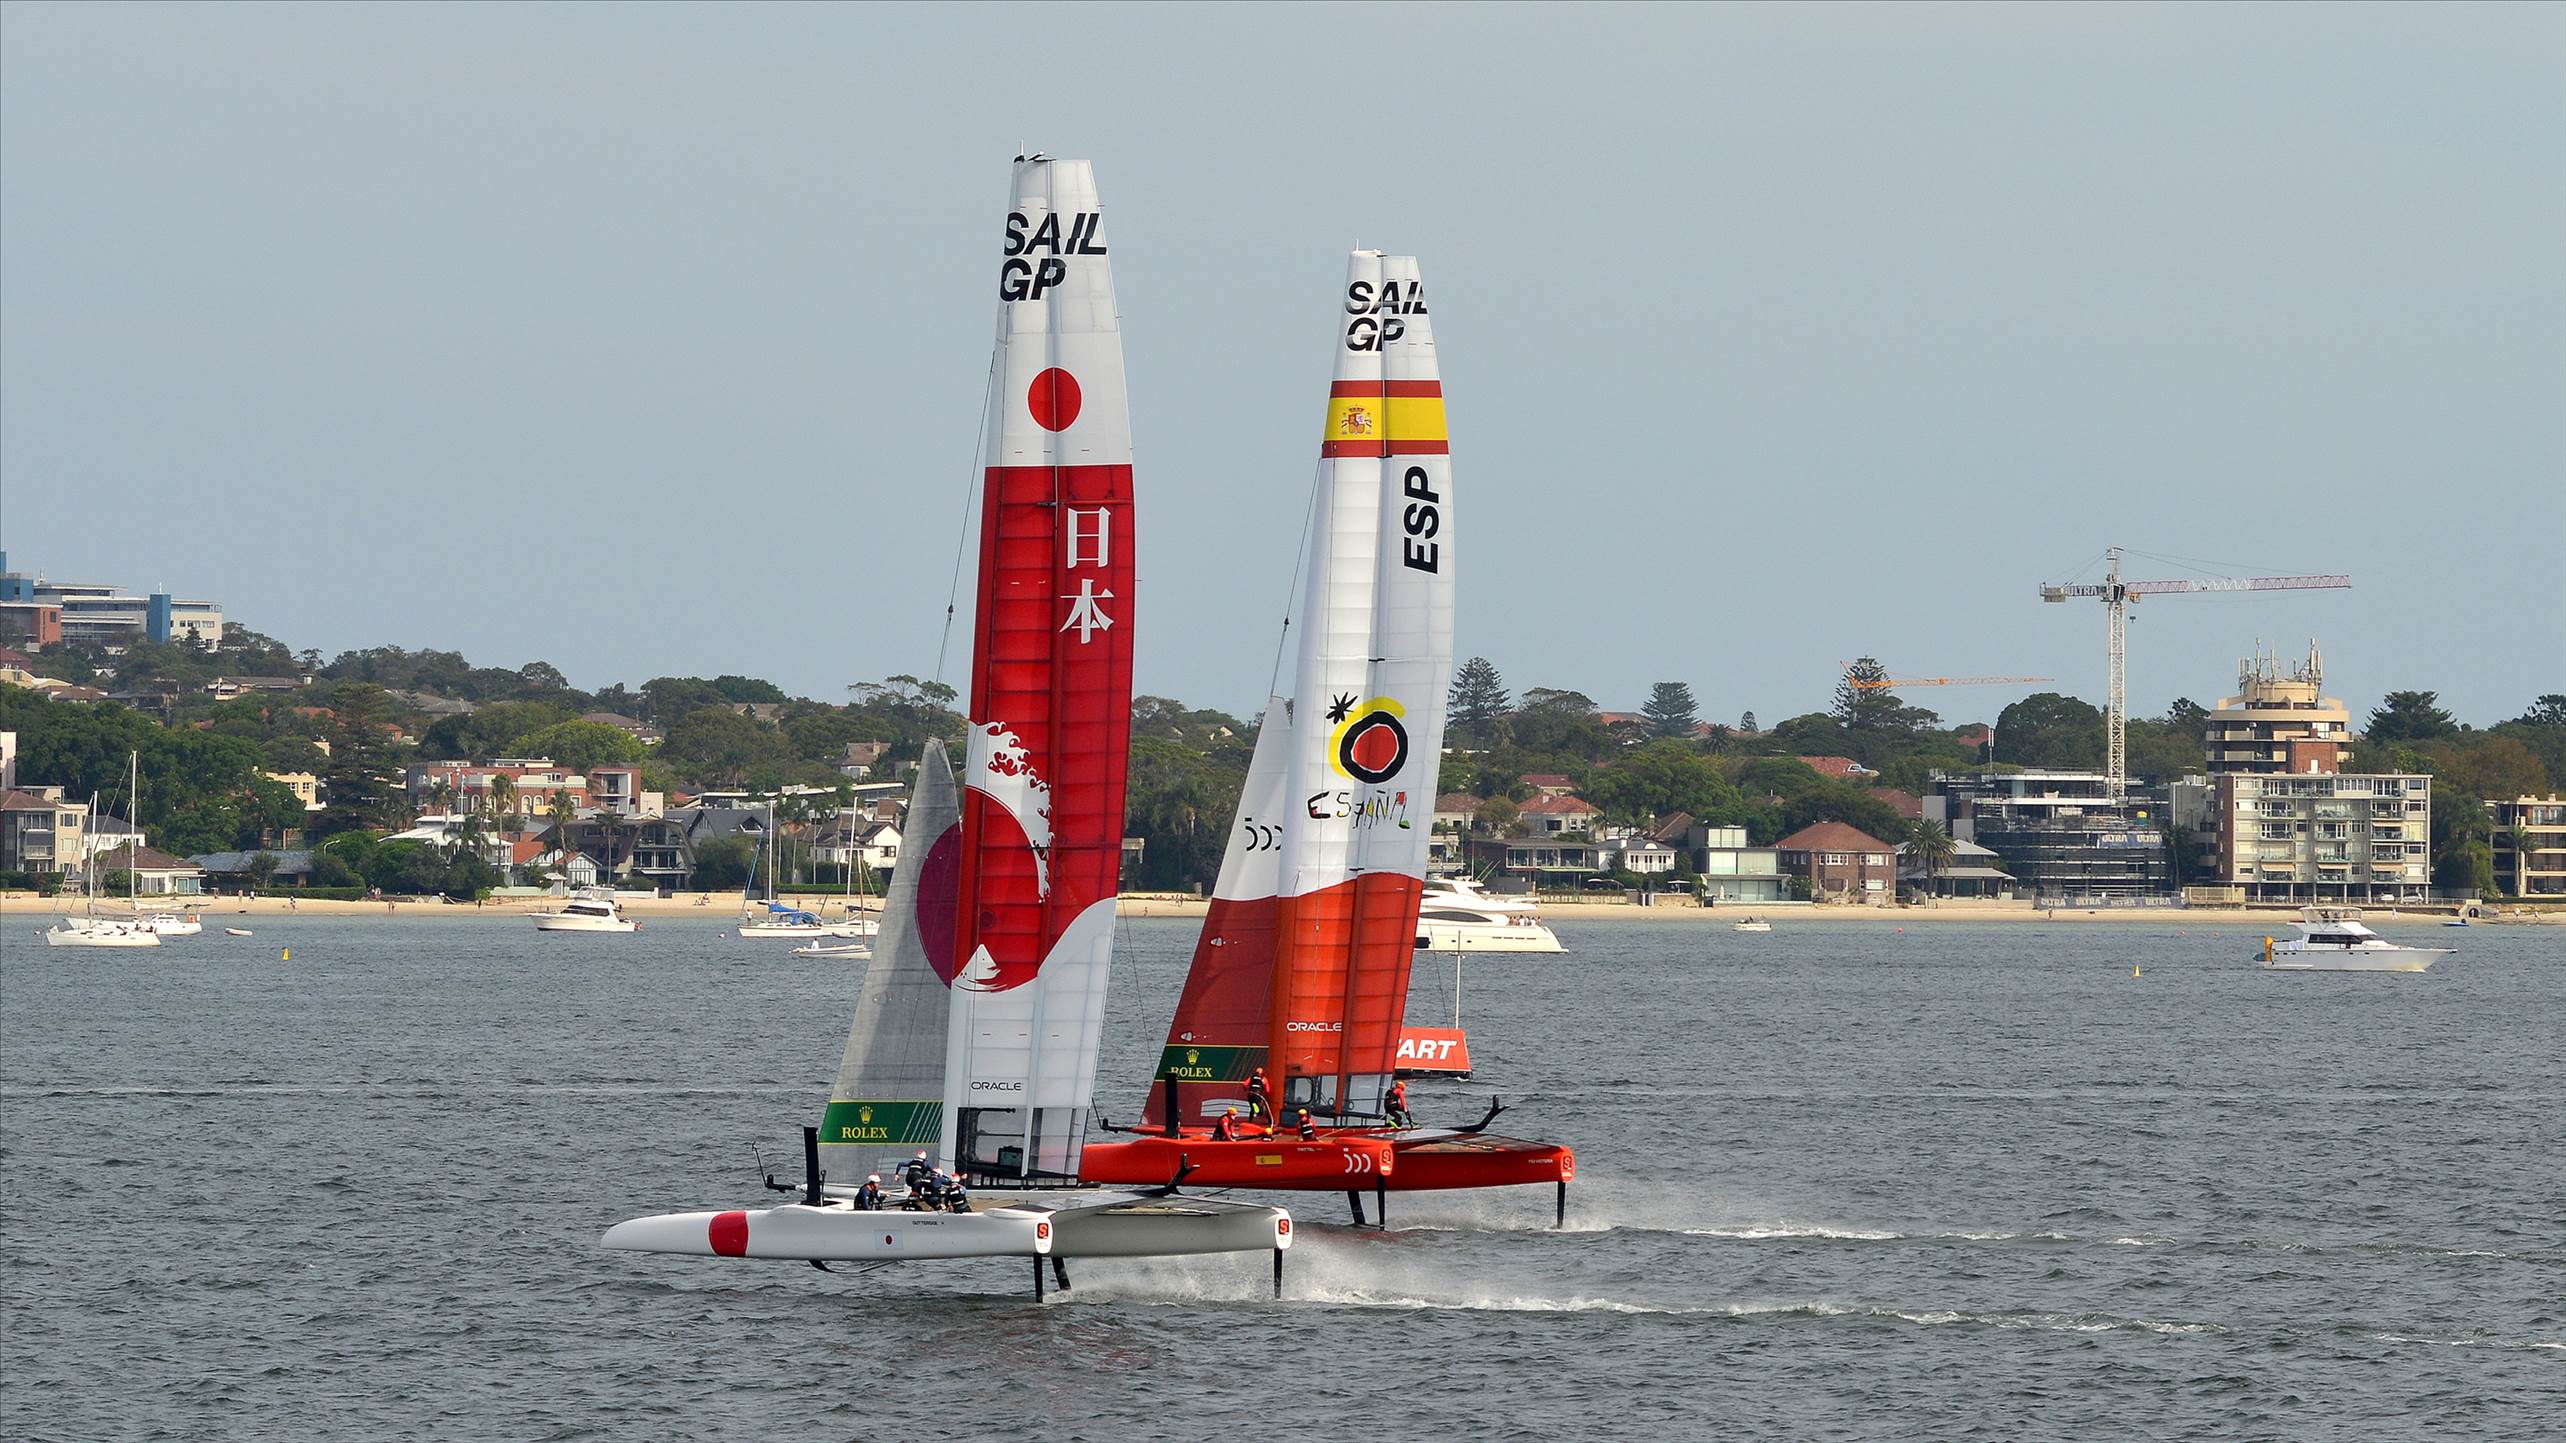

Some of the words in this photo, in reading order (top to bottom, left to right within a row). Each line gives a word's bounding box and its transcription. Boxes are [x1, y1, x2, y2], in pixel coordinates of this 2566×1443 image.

[1004, 212, 1106, 255] SAIL
[1000, 258, 1066, 301] GP
[1345, 281, 1428, 315] SAIL
[1345, 317, 1405, 351] GP
[1404, 466, 1439, 574] ESP
[1059, 506, 1114, 644] 日本
[1286, 1022, 1342, 1032] ORACLE
[1396, 1038, 1457, 1060] ART
[971, 1081, 1022, 1091] ORACLE
[841, 1126, 888, 1139] ROLEX
